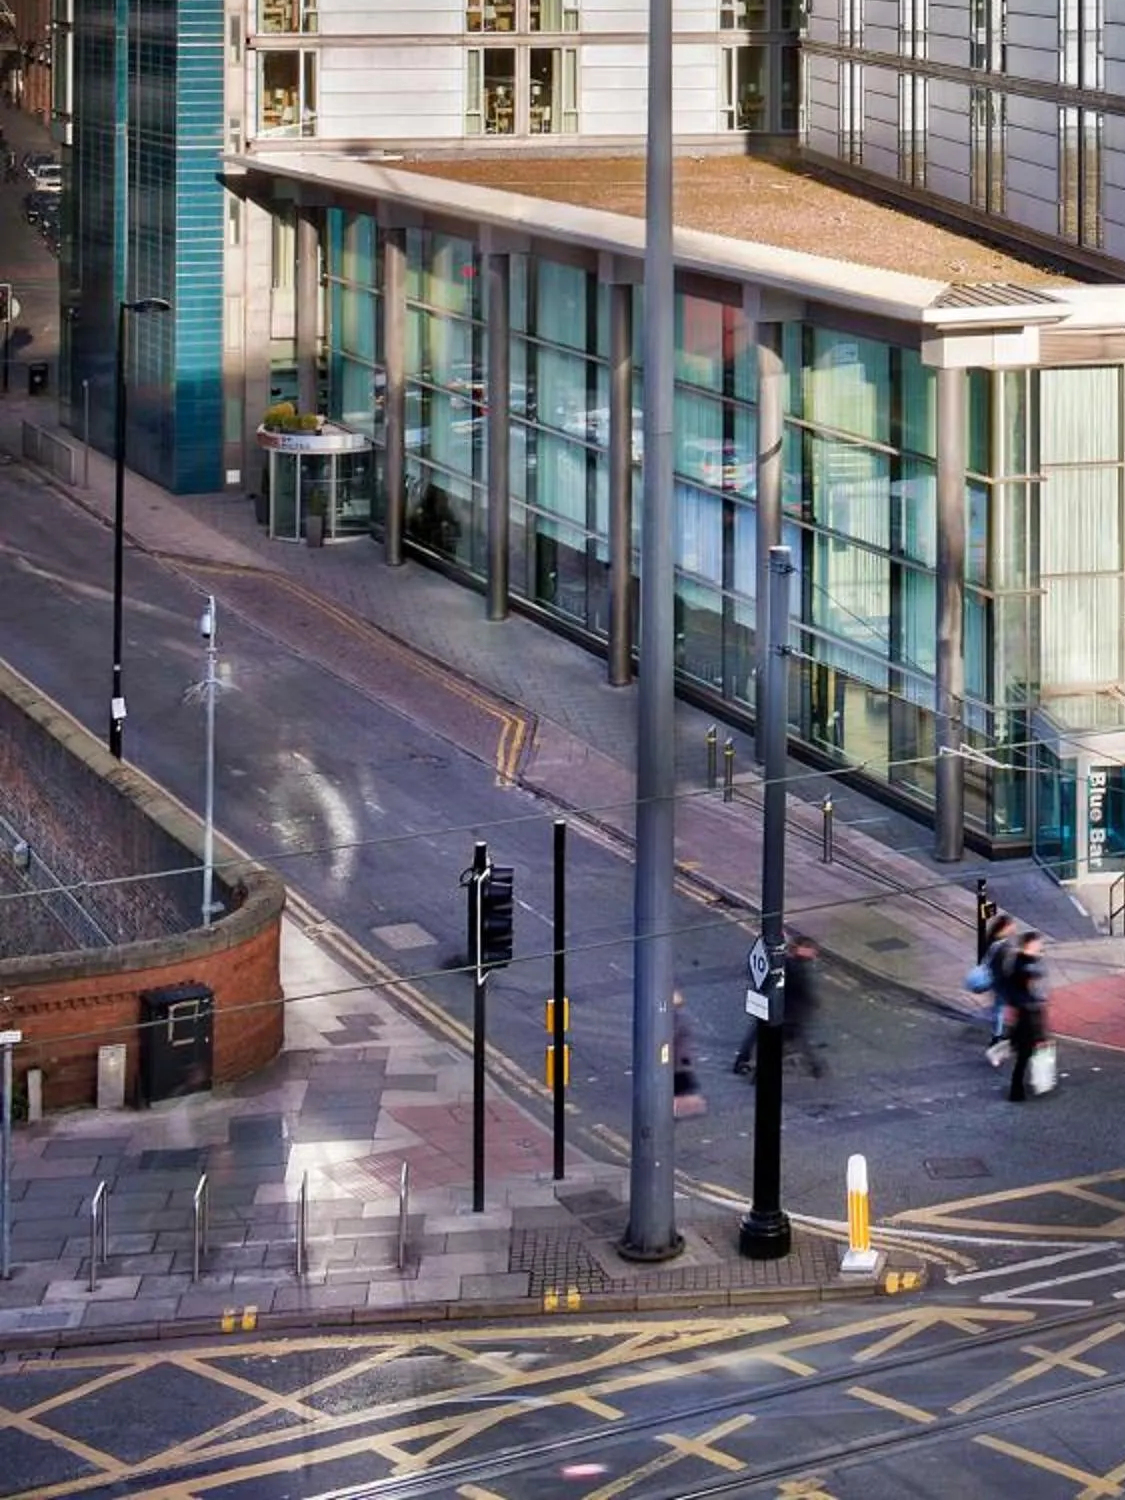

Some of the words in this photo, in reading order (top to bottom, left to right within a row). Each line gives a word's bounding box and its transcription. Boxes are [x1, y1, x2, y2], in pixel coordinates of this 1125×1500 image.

[1089, 771, 1106, 822] Blue
[1089, 827, 1106, 868] Bar
[753, 954, 765, 973] 10
